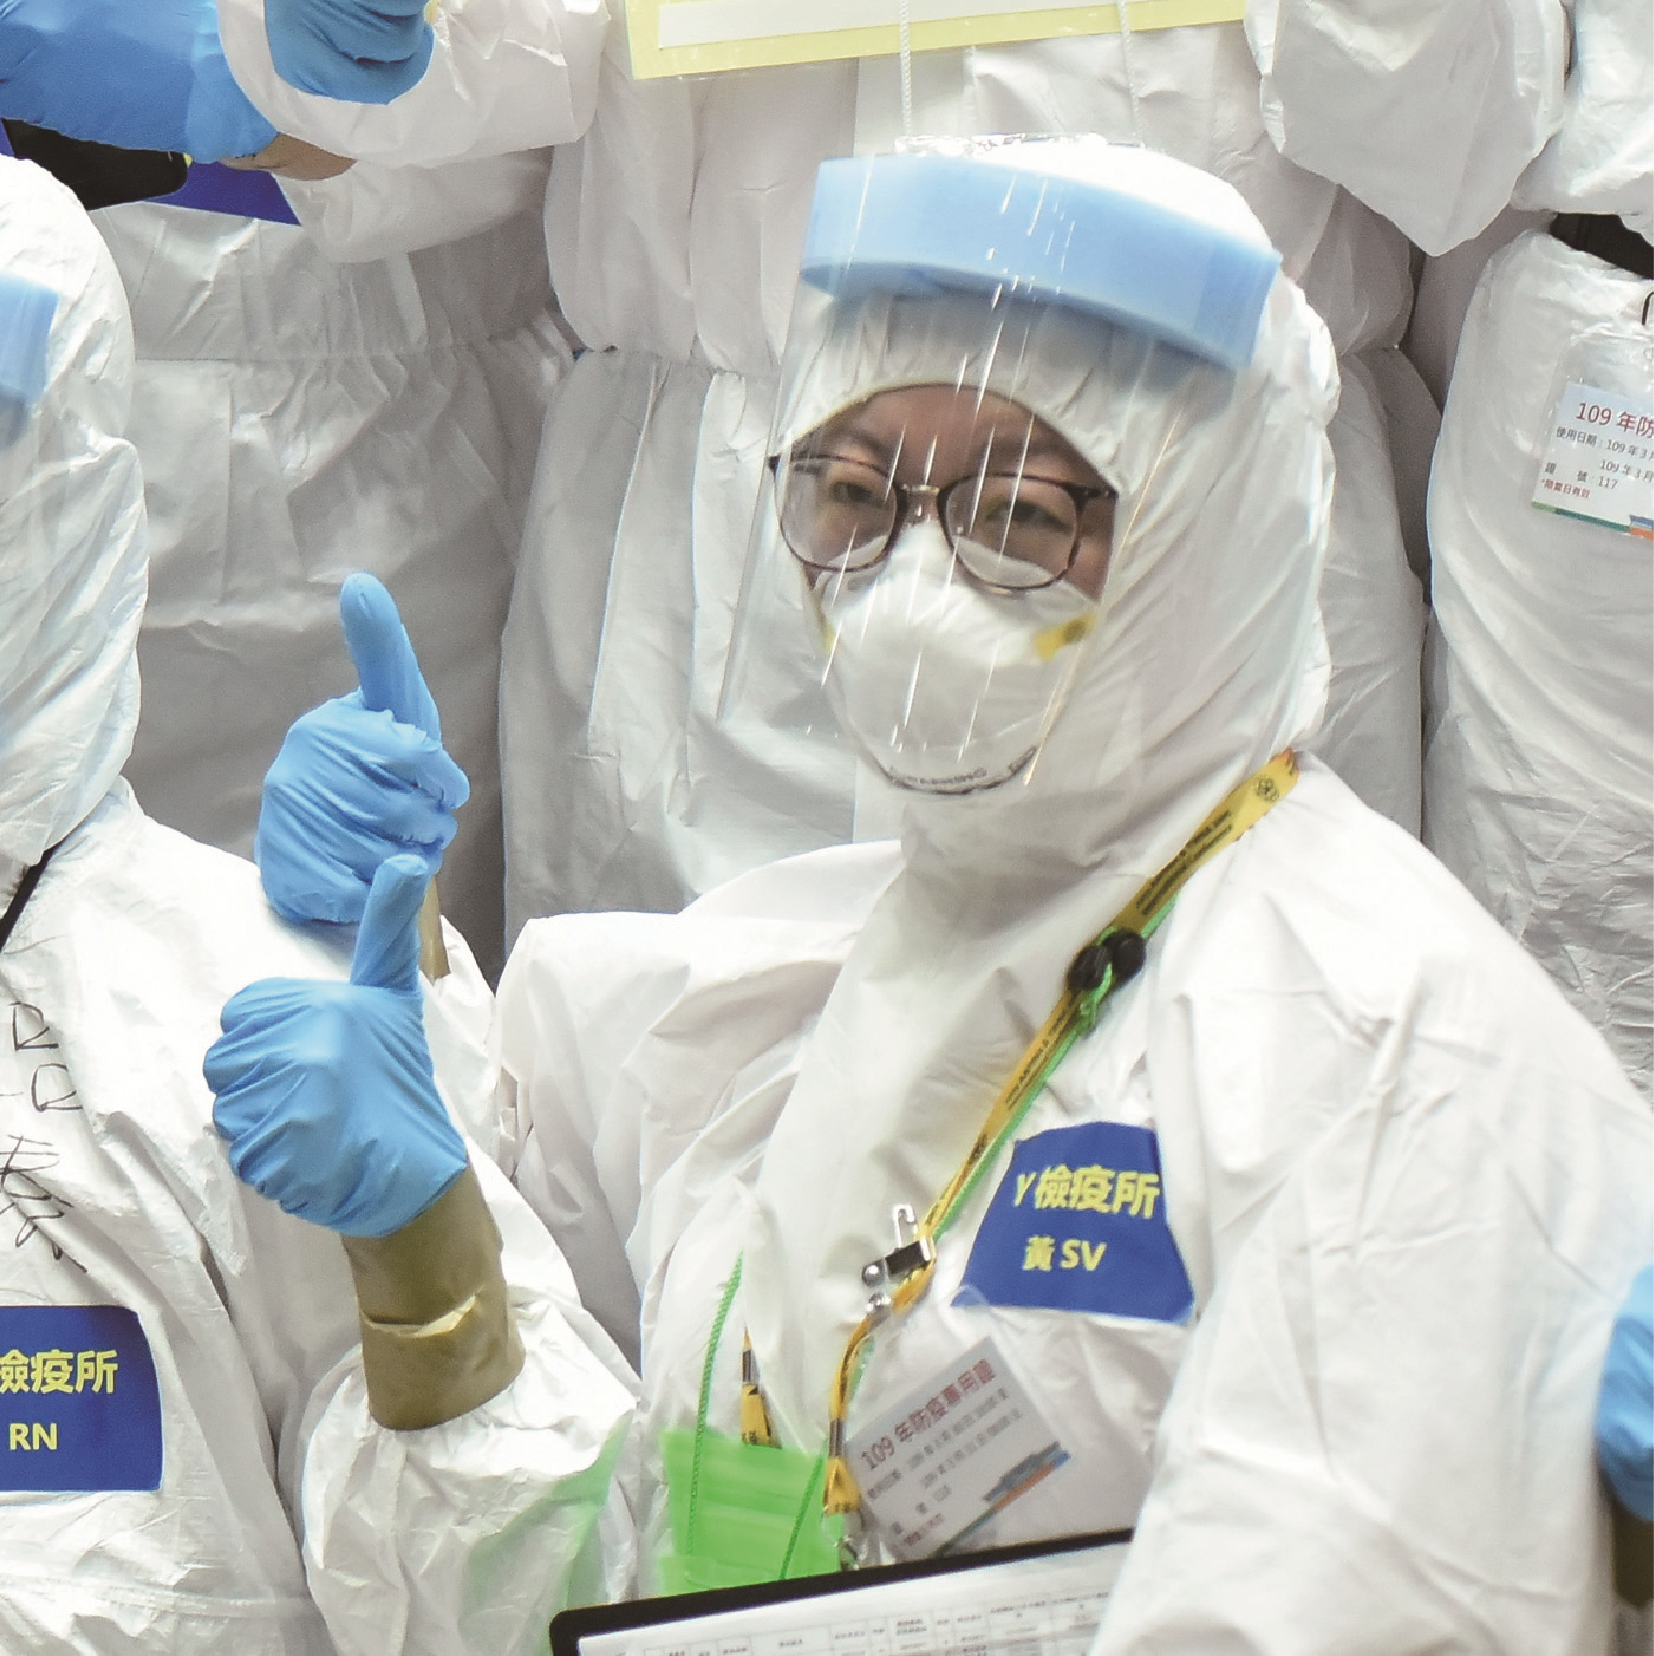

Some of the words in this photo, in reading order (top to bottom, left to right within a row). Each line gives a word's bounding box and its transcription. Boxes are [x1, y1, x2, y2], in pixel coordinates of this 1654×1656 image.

[1575, 402, 1612, 427] 109
[1013, 1171, 1037, 1208] Y
[1035, 1163, 1161, 1220] 檢疫所
[8, 1421, 59, 1451] RN
